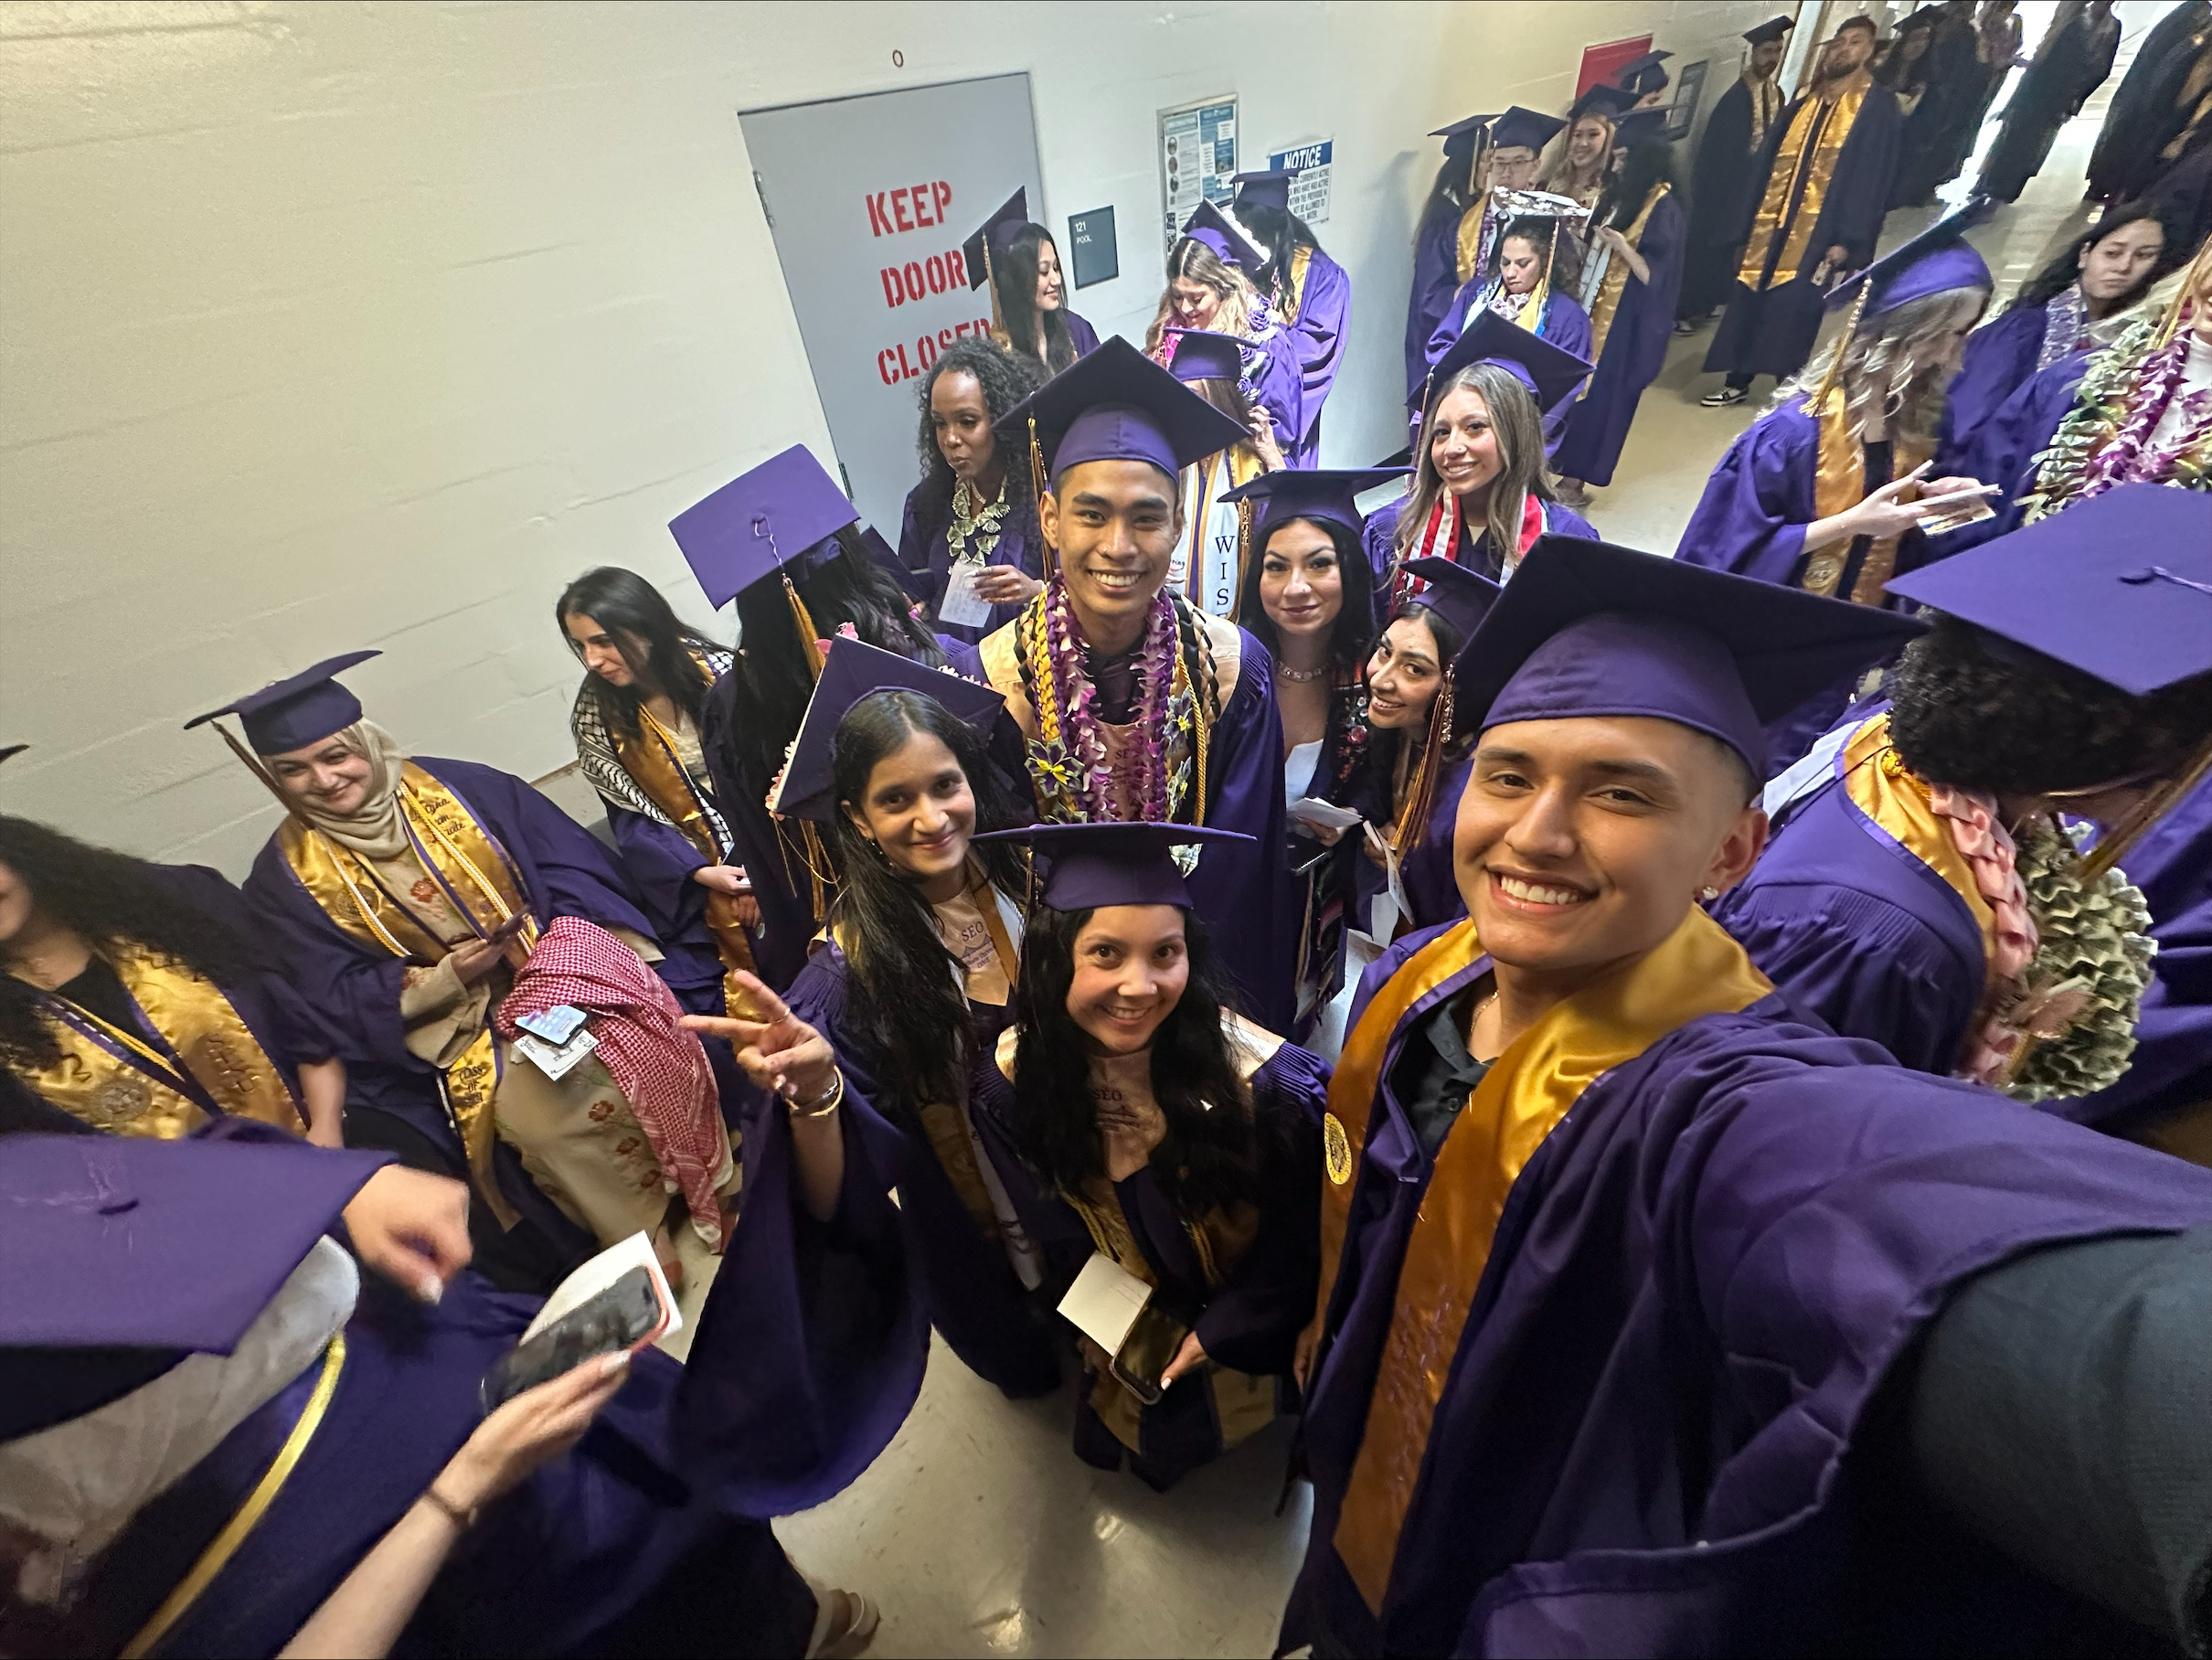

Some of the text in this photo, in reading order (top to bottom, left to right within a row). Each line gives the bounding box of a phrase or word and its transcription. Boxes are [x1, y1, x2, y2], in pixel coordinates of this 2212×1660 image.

[1283, 145, 1322, 170] NOTICE
[866, 181, 952, 238] KEEP
[1075, 221, 1086, 232] 121
[1076, 235, 1092, 244] POOL
[880, 250, 967, 308] DOOR
[1215, 536, 1236, 617] WIS
[962, 920, 984, 942] SEO
[1092, 1089, 1122, 1101] SEO
